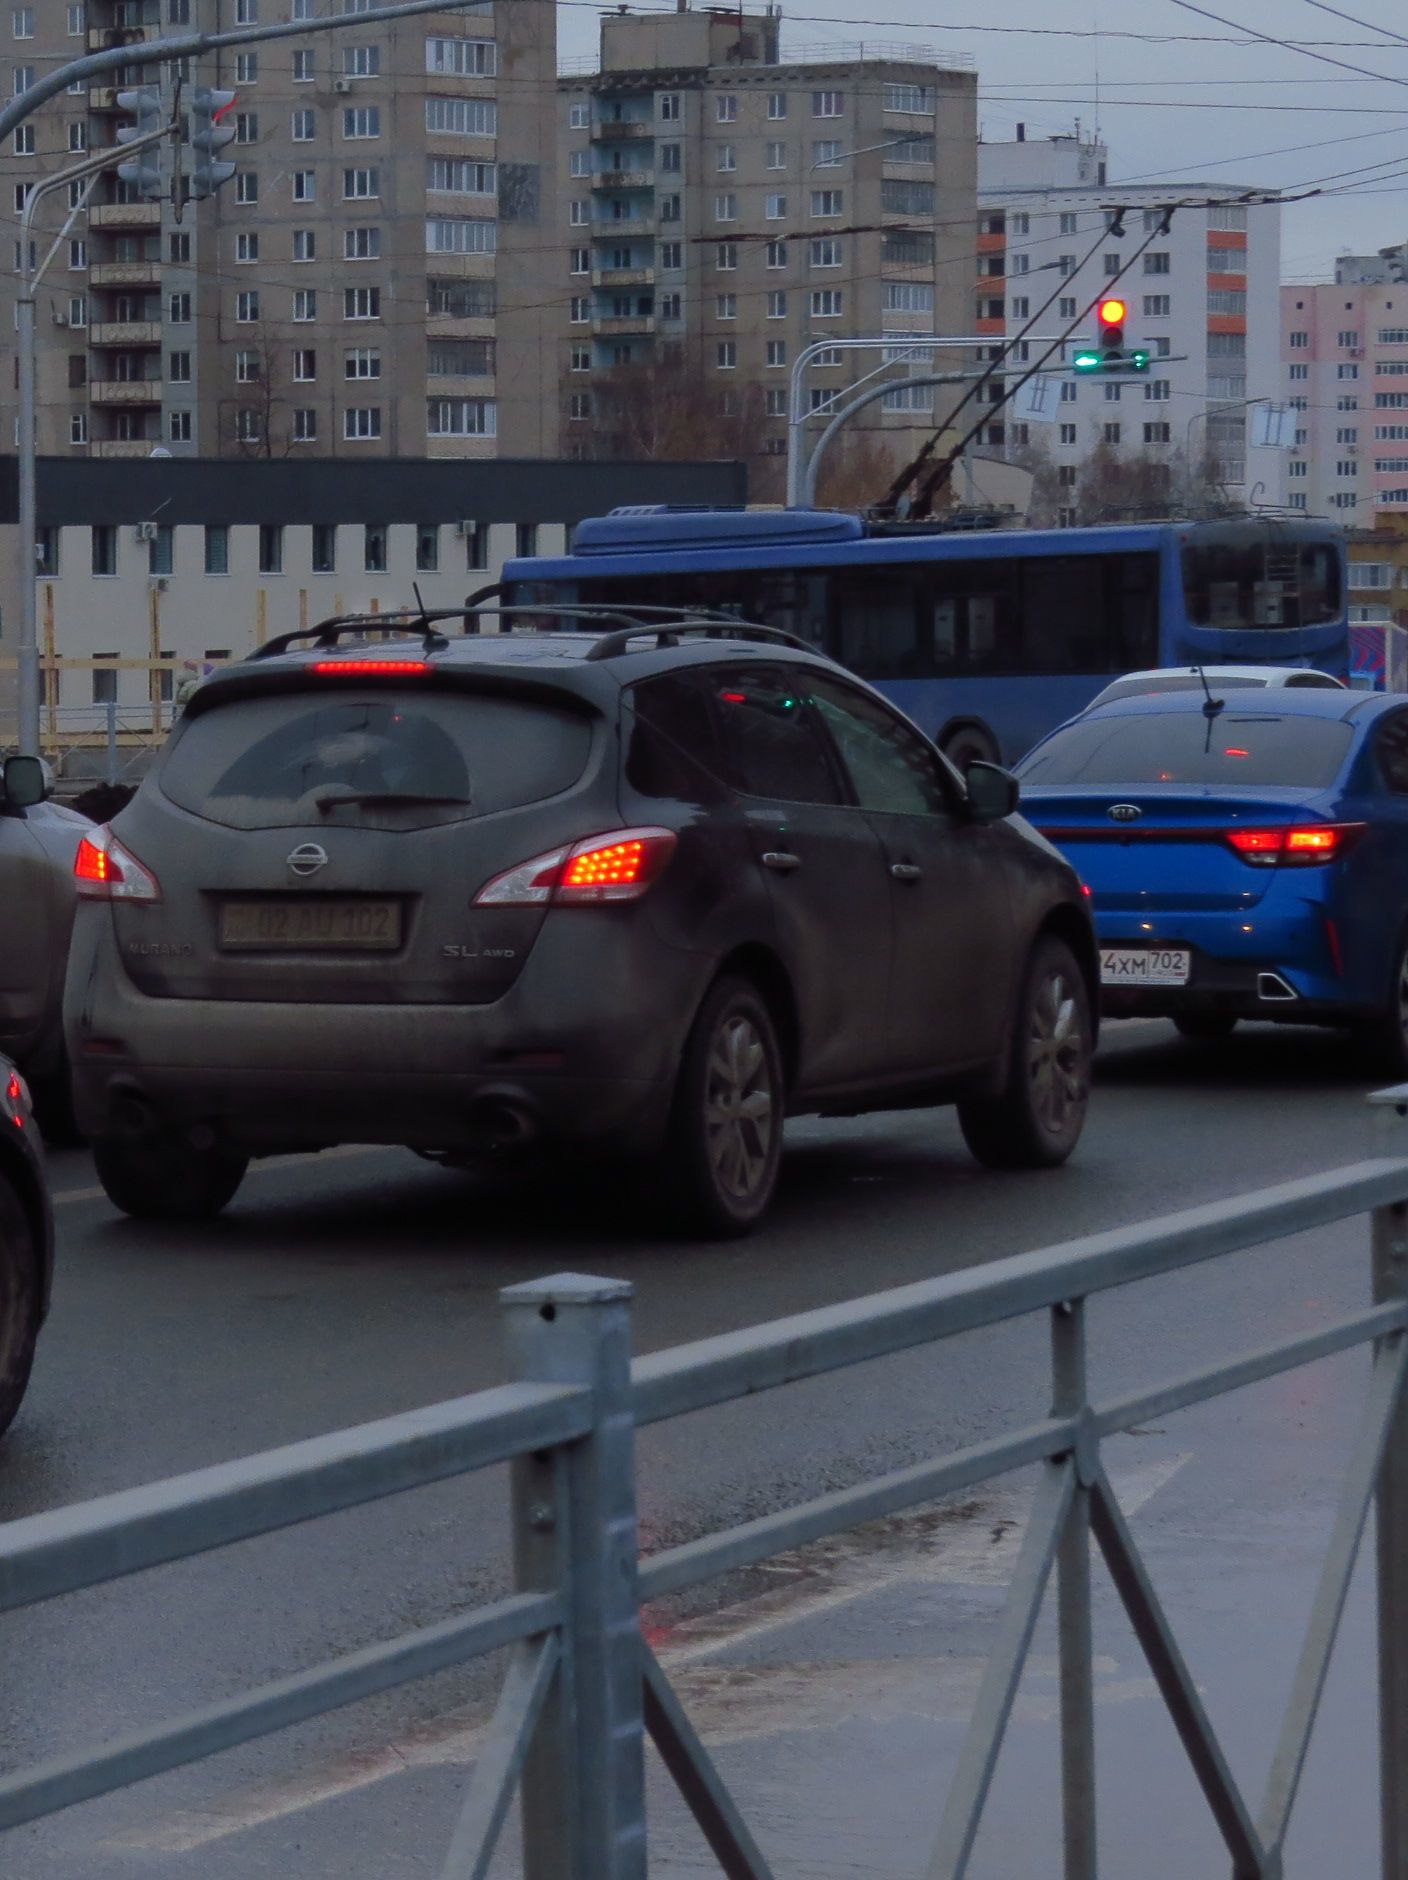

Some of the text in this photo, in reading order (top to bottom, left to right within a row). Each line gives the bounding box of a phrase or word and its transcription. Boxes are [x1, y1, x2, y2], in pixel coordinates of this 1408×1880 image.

[442, 945, 515, 958] SL AWD
[1151, 951, 1183, 970] 702
